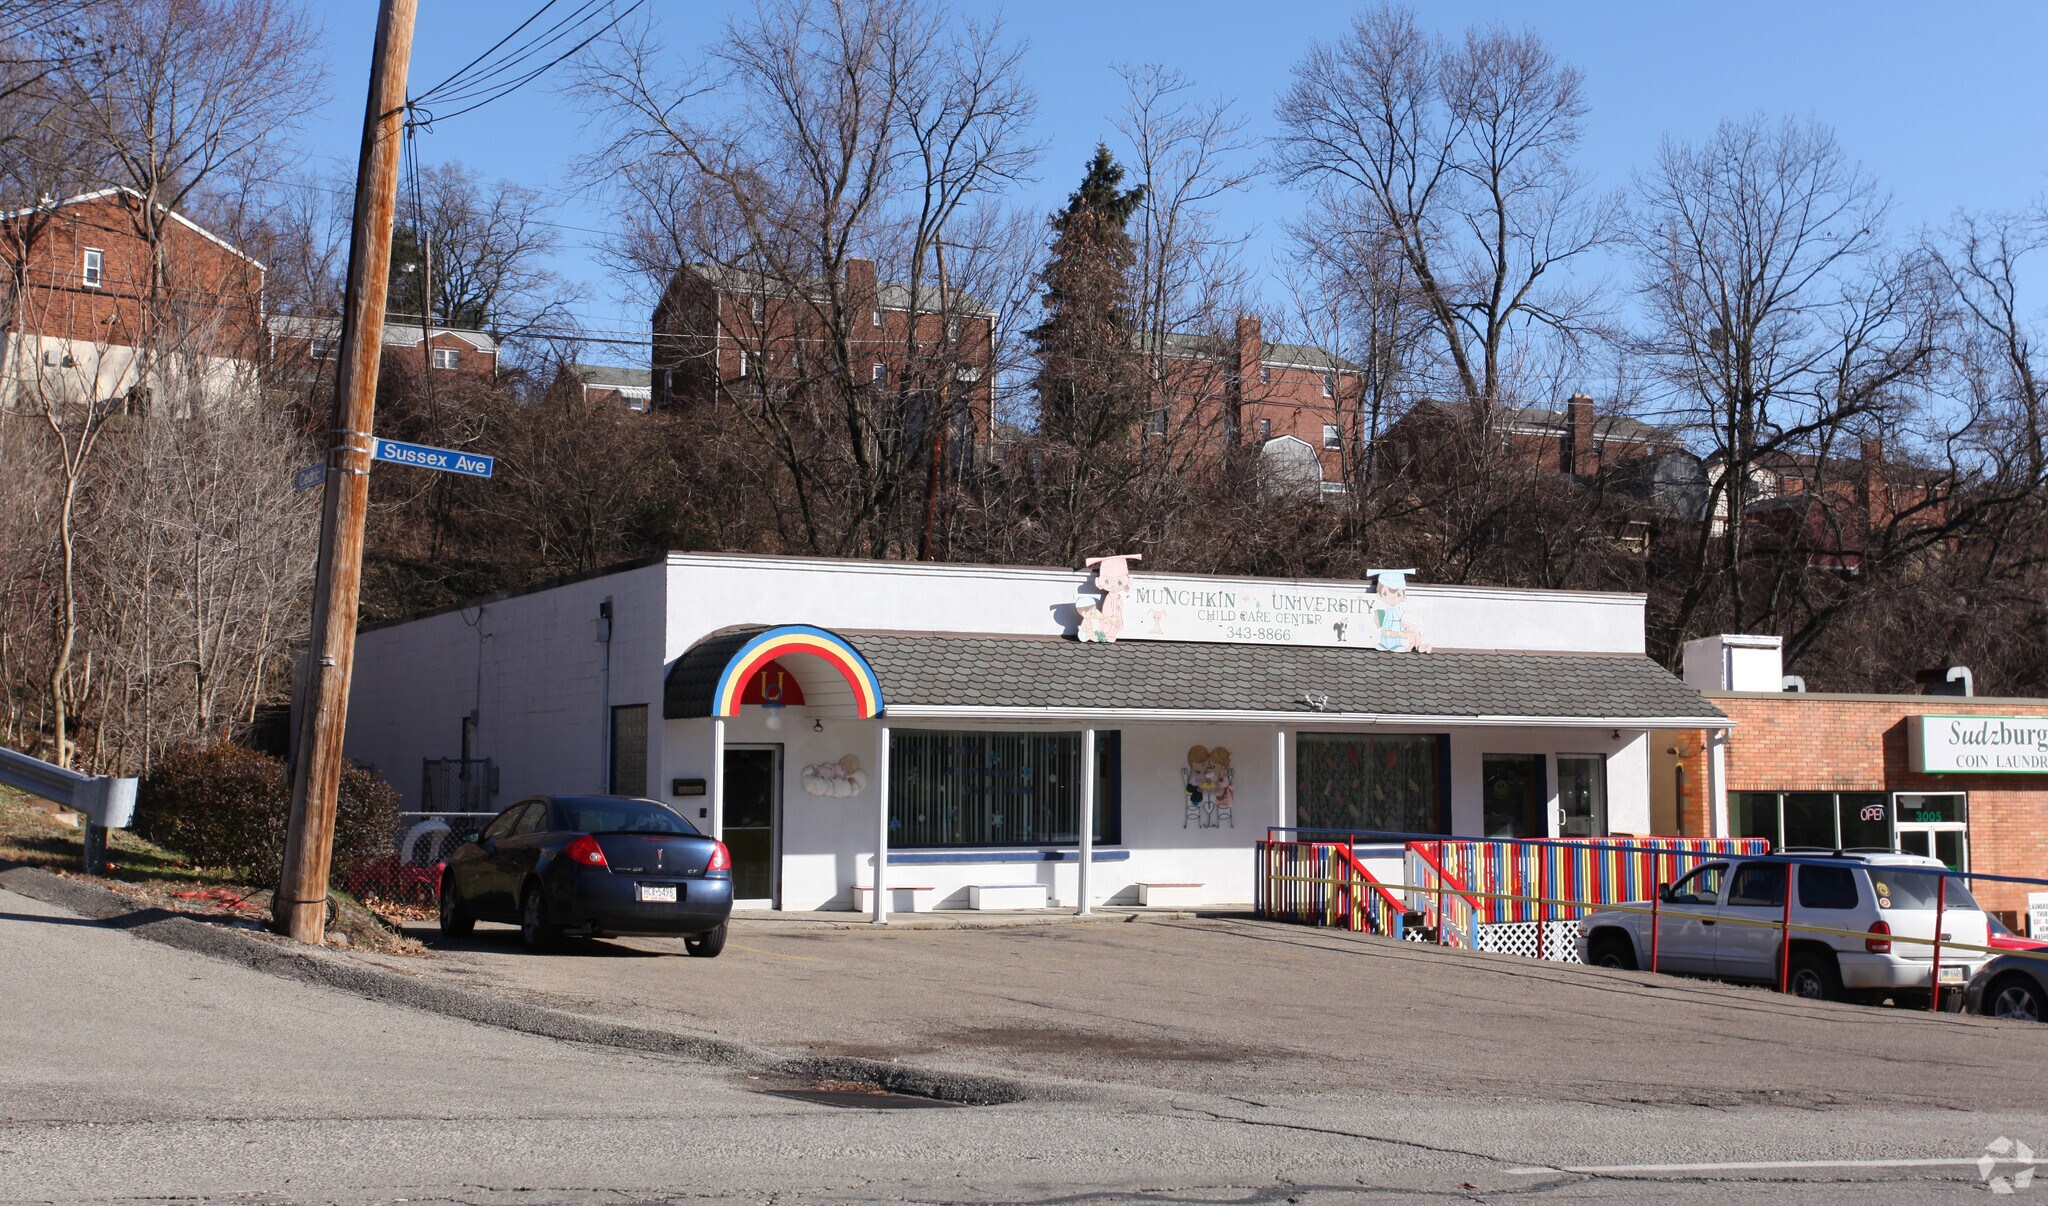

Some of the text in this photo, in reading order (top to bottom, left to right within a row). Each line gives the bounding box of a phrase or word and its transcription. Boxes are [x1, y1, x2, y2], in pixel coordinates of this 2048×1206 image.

[384, 443, 486, 473] Sussex Ave
[1136, 587, 1376, 614] MUNCHKIN UNIVERSITY
[1197, 610, 1323, 625] CHILD CARE CENTER
[1226, 626, 1291, 641] 343-8866
[1949, 720, 2048, 752] Sudzburg
[1956, 754, 1989, 768] COIN
[1860, 808, 1885, 821] OPEN
[1915, 811, 1942, 822] 3005
